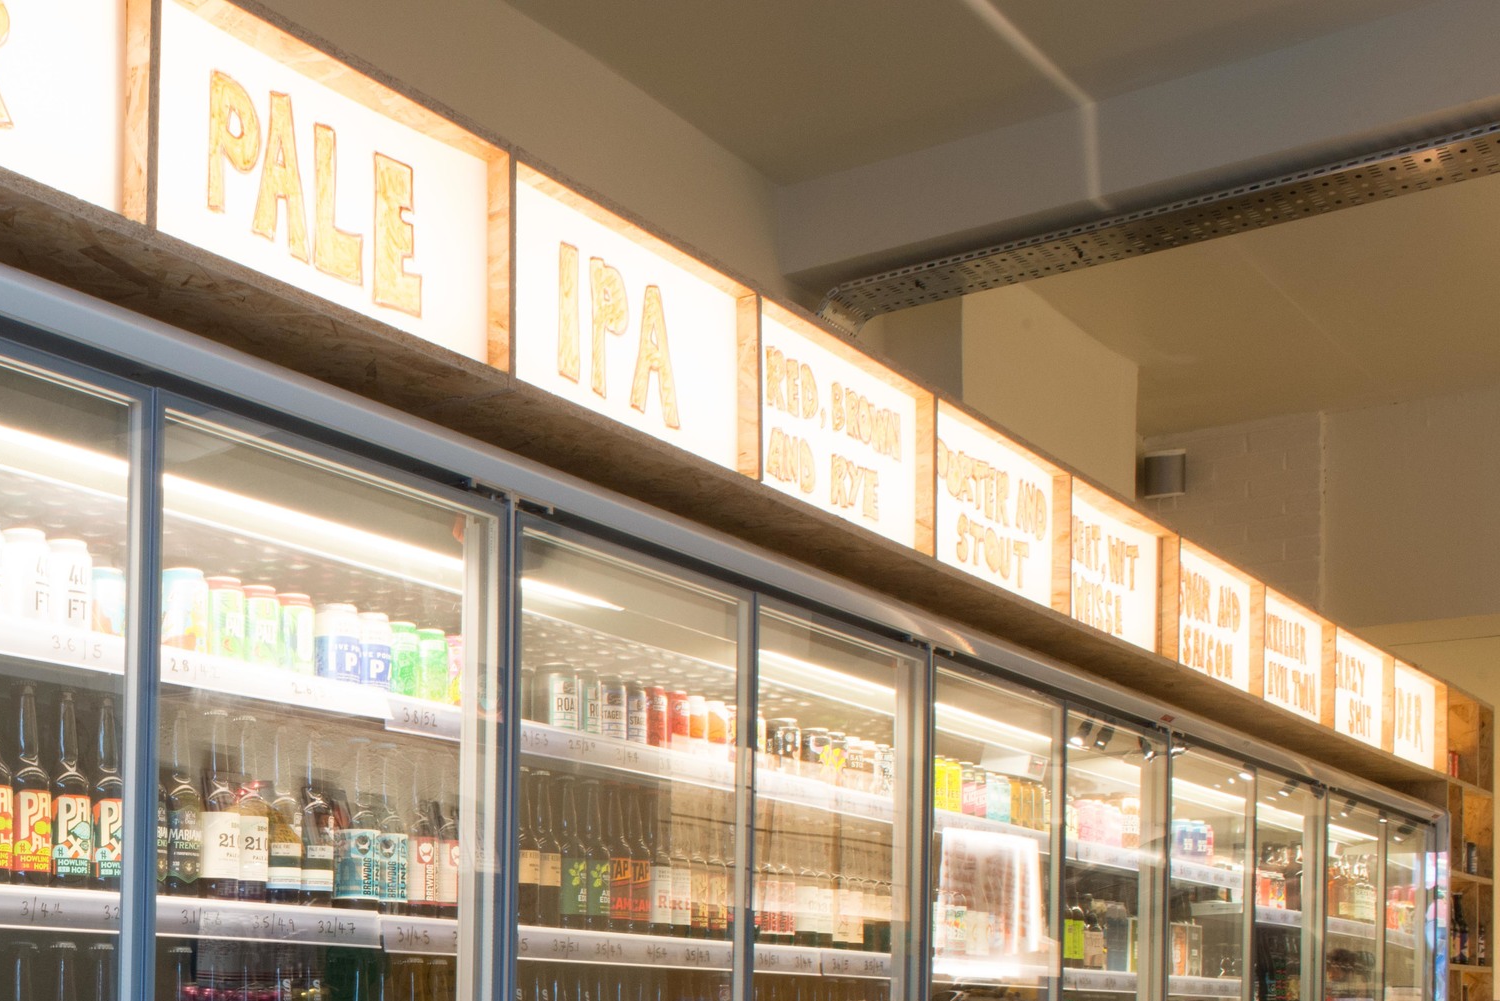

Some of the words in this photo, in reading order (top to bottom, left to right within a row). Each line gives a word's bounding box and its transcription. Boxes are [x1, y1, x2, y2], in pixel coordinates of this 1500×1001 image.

[204, 67, 423, 319] PALE
[557, 240, 681, 431] IPA
[765, 344, 827, 429] RED,
[830, 381, 901, 463] BROWN
[765, 426, 816, 494] AND
[830, 453, 879, 521] RYE
[1016, 477, 1048, 541] AND
[955, 512, 1029, 588] STOUT
[57, 858, 88, 867] HOWLING
[71, 866, 88, 875] HOPS
